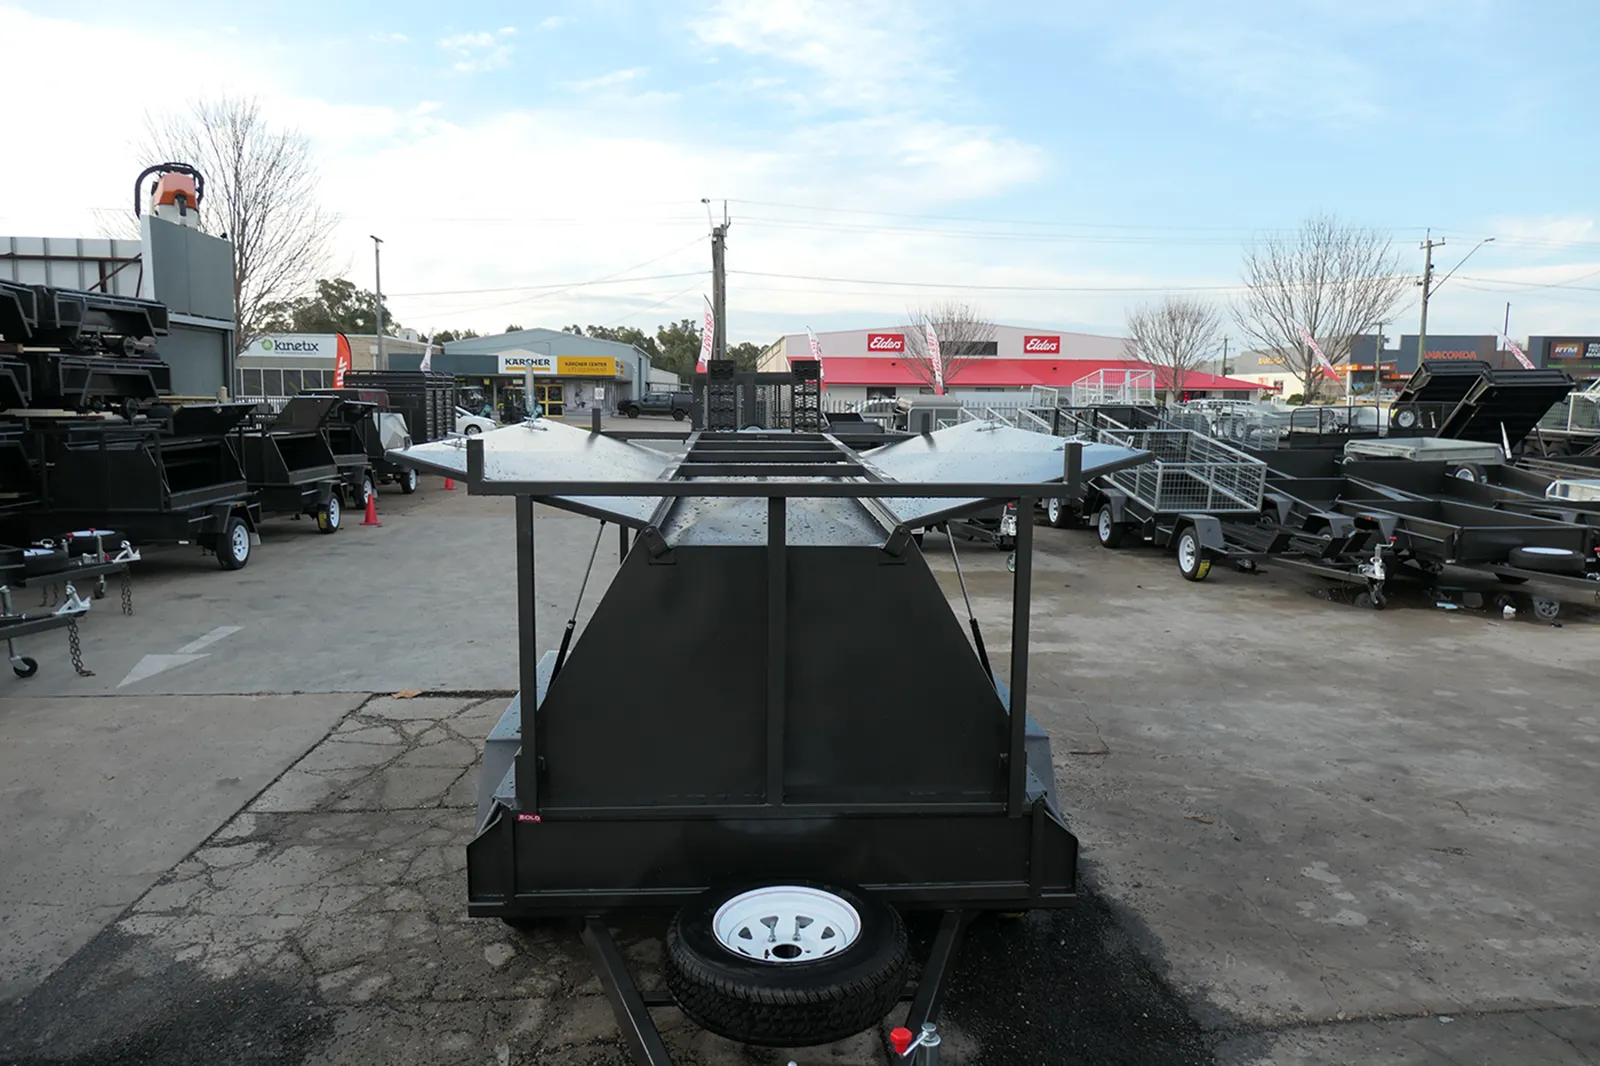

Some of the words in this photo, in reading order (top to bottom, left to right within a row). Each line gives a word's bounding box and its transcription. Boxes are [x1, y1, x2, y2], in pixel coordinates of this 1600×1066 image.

[274, 340, 319, 351] kinetix
[870, 336, 901, 349] Elders
[1026, 338, 1057, 351] Elders
